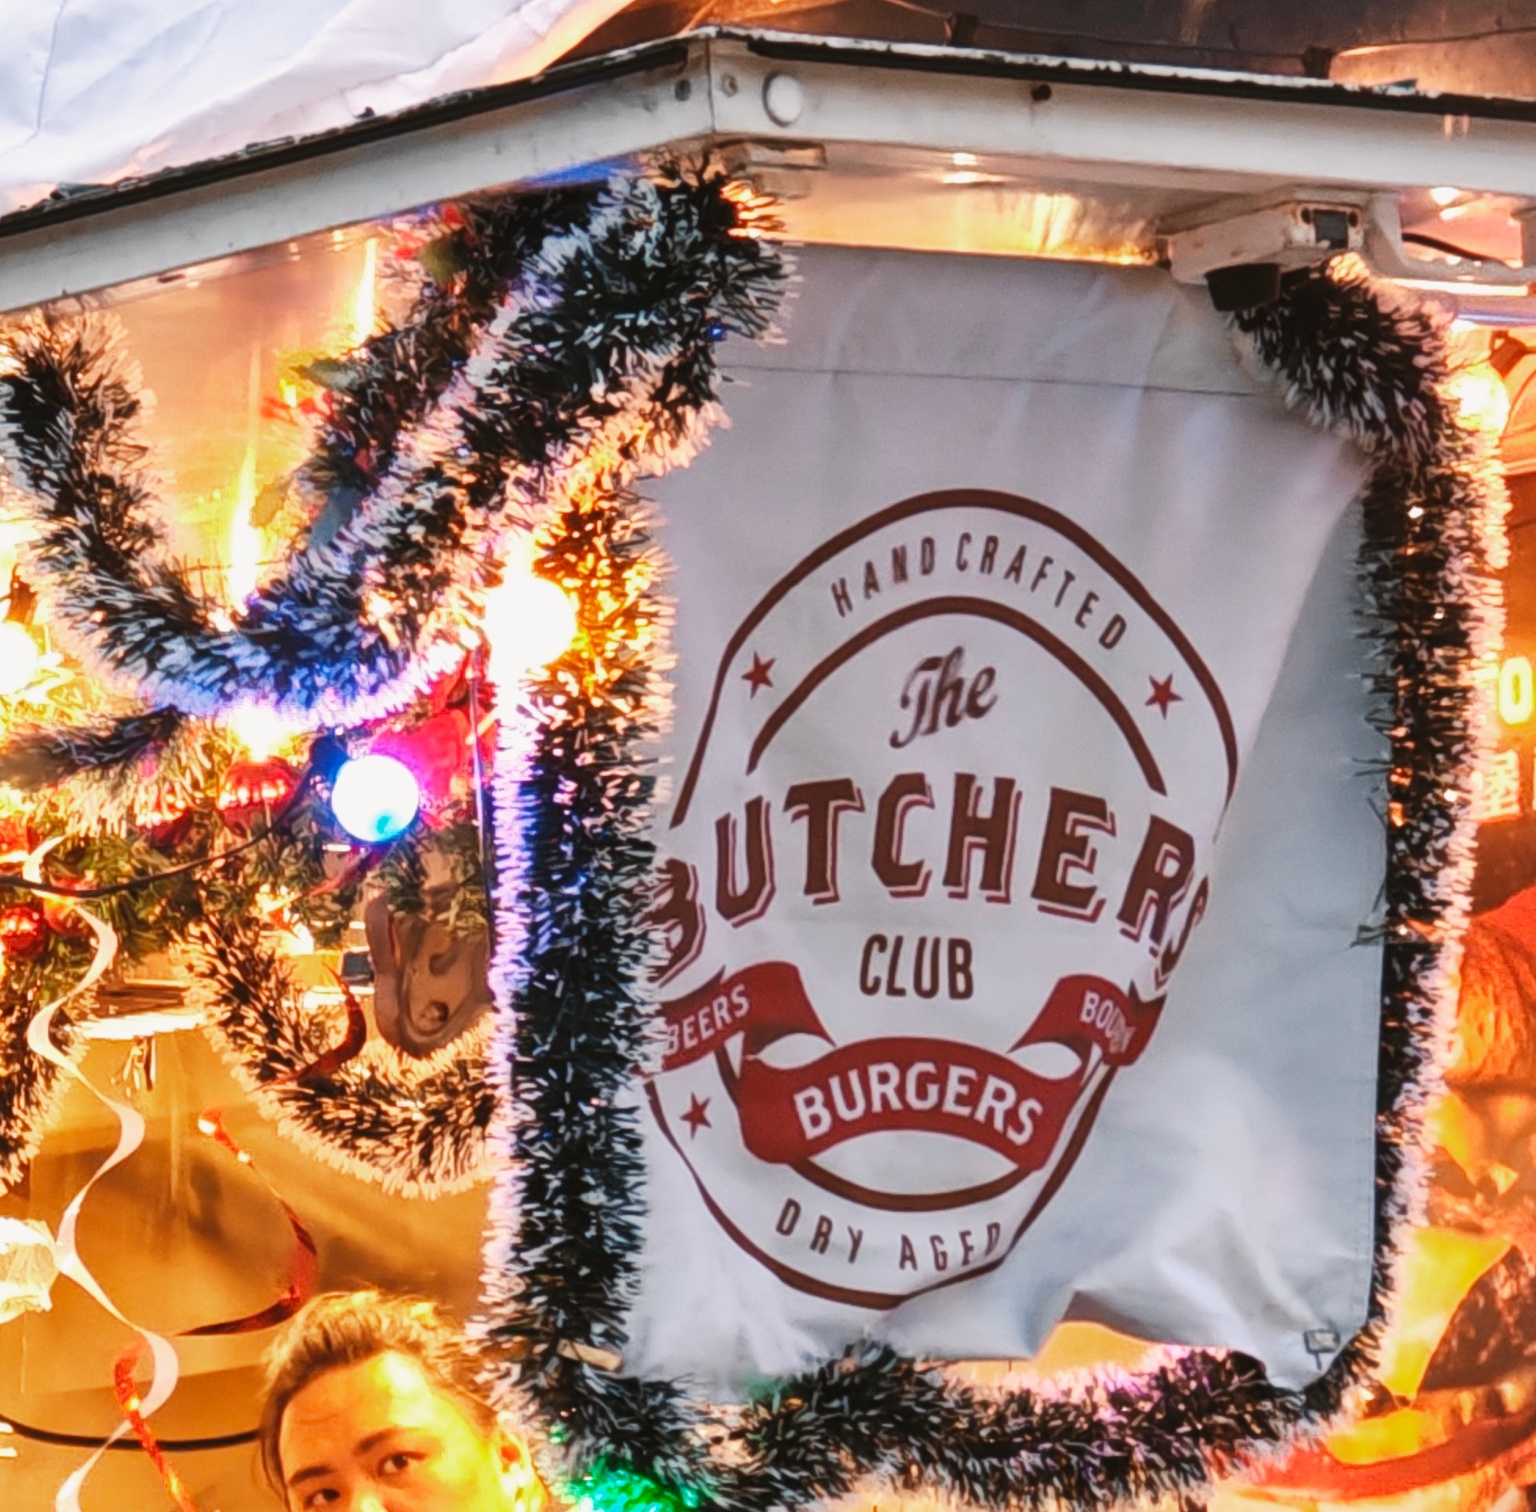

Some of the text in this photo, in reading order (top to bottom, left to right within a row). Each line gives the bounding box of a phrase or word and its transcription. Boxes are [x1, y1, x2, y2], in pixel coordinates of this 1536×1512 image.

[890, 646, 998, 748] The
[859, 934, 974, 999] CLUB
[663, 983, 750, 1055] BEERS
[792, 1062, 1044, 1146] BURGERS
[775, 1199, 1002, 1271] DRY AGED
